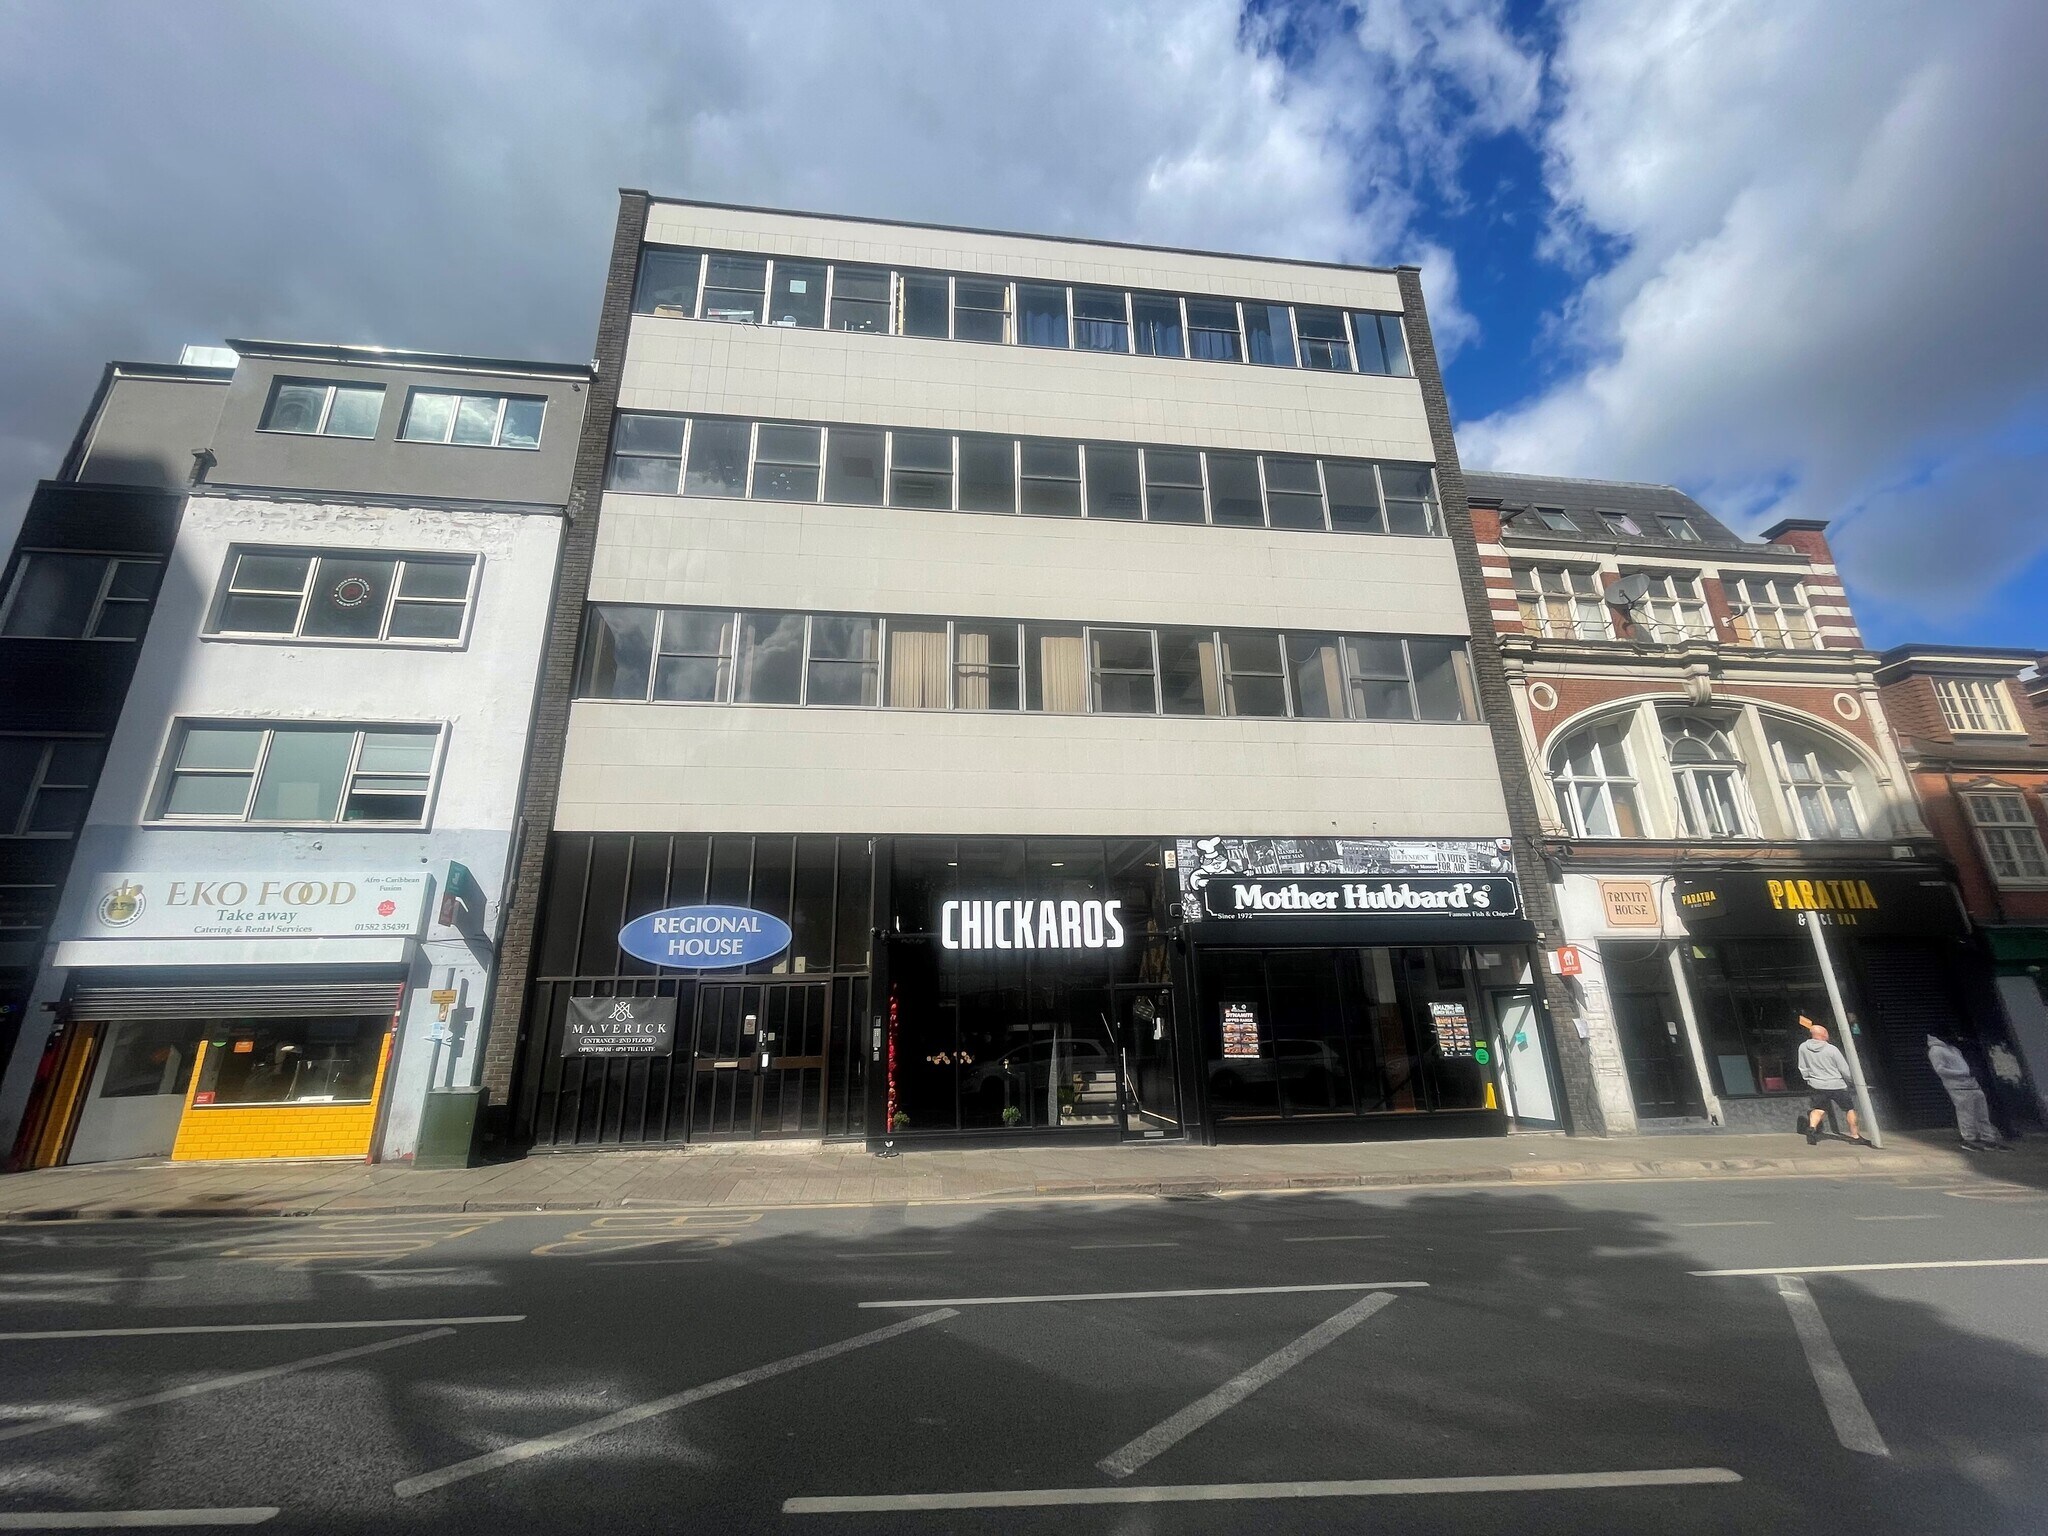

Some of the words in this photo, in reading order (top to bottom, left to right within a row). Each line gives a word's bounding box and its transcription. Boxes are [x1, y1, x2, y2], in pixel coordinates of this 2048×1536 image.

[1437, 852, 1446, 861] UN
[1447, 853, 1467, 864] VOTES
[1438, 862, 1451, 870] FOR
[1453, 863, 1465, 872] AIR
[166, 881, 248, 907] EKO
[257, 881, 357, 906] FOOD
[1232, 883, 1340, 910] Mother
[1341, 883, 1490, 909] Hubbard's
[1606, 891, 1648, 902] TRINITY
[1681, 890, 1717, 905] PARATHA
[1766, 879, 1879, 910] PARATHA
[217, 909, 254, 921] Take
[257, 911, 298, 924] away
[1614, 904, 1648, 915] HOUSE
[354, 923, 379, 931] 01582
[381, 923, 410, 931] 354391
[653, 916, 762, 934] REGIONAL
[942, 900, 1125, 949] CHICKAROS
[1797, 913, 1806, 926] &
[193, 925, 232, 935] Catering
[245, 925, 273, 933] Rental
[276, 924, 312, 933] Services
[668, 938, 743, 956] HOUSE
[571, 1023, 667, 1034] MAVERICK
[530, 1213, 764, 1257] BUS
